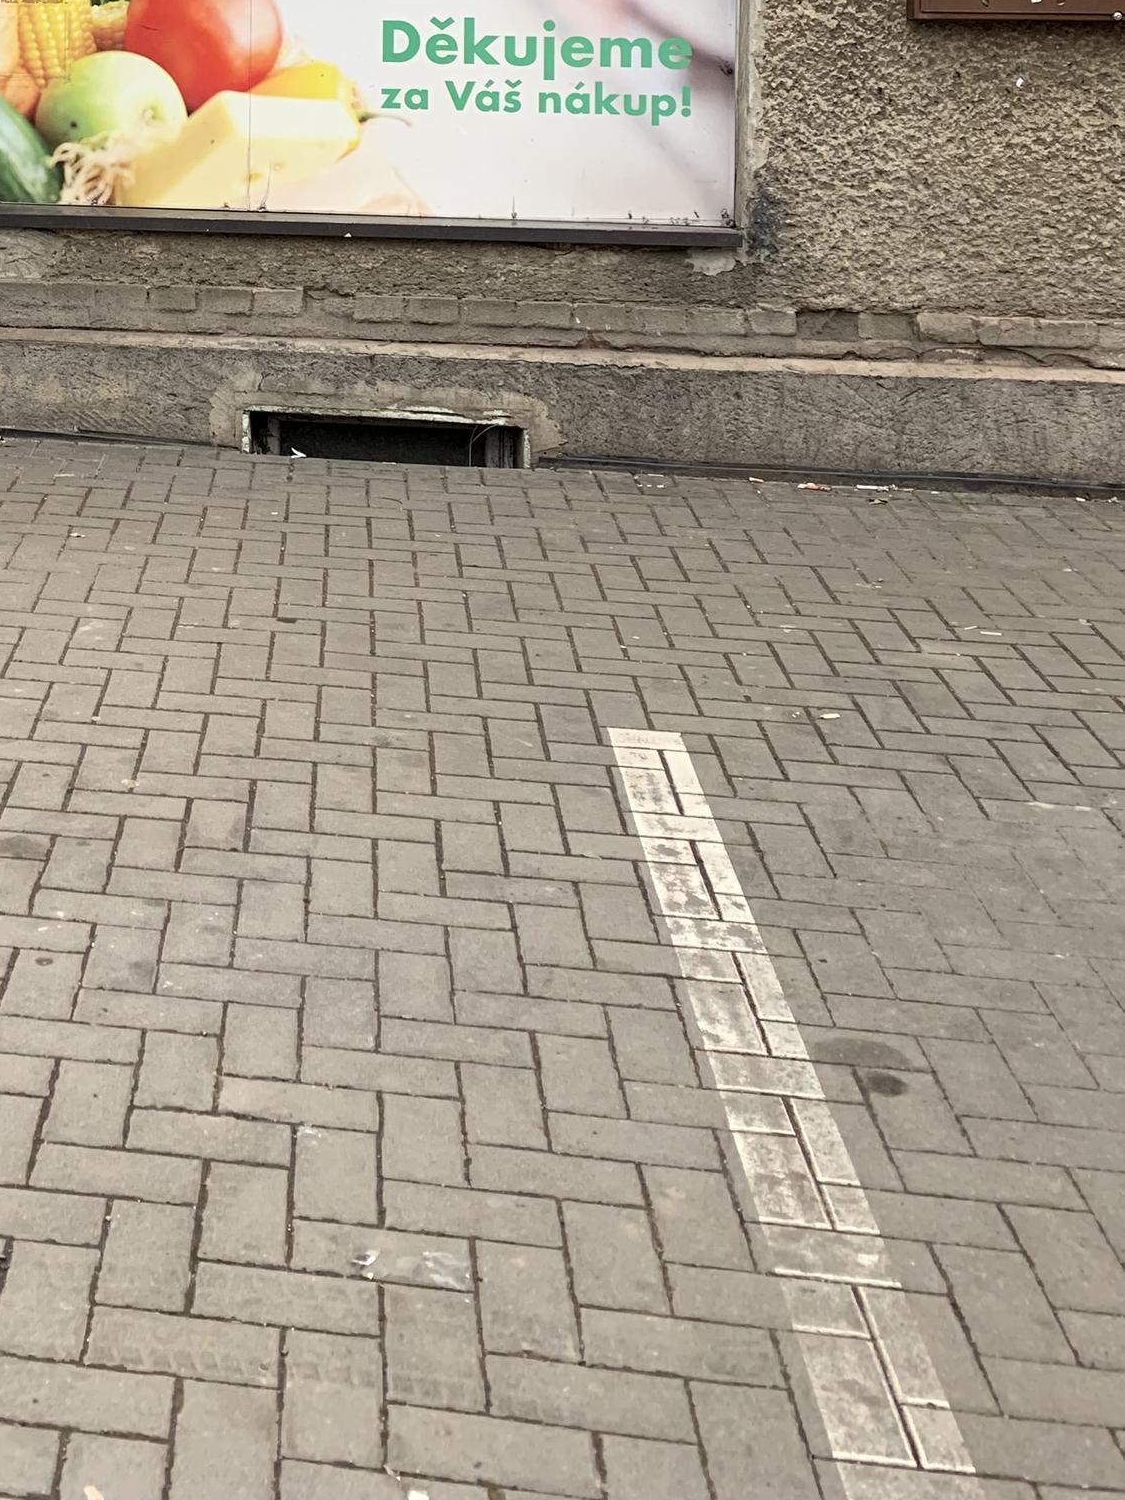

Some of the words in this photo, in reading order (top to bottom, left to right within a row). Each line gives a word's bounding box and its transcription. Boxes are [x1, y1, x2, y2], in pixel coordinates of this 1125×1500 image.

[382, 17, 693, 80] Děkujeme
[380, 88, 429, 110] za
[444, 79, 523, 113] Váš
[538, 81, 692, 126] nákup!
